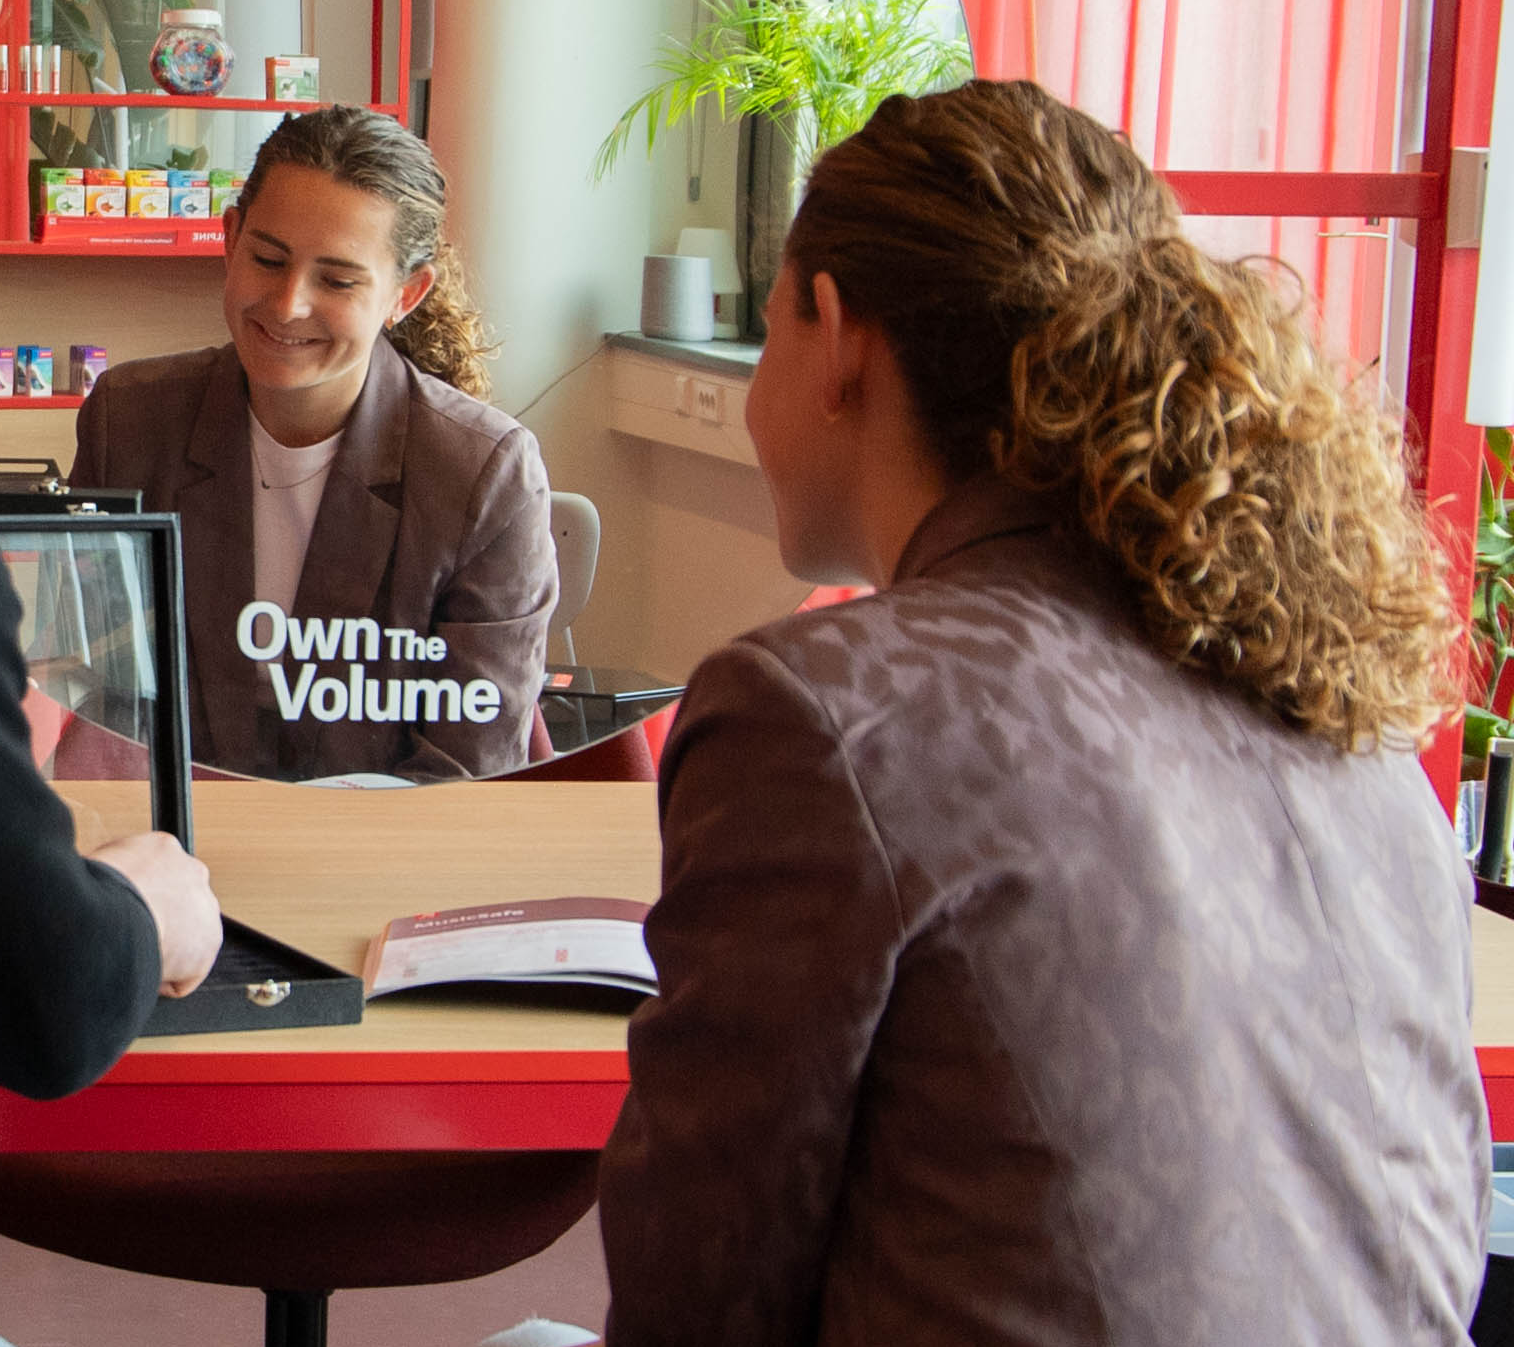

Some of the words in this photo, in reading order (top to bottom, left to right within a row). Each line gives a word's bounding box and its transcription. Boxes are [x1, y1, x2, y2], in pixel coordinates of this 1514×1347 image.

[236, 600, 381, 662] Own
[383, 627, 448, 663] The
[267, 662, 502, 724] Volume
